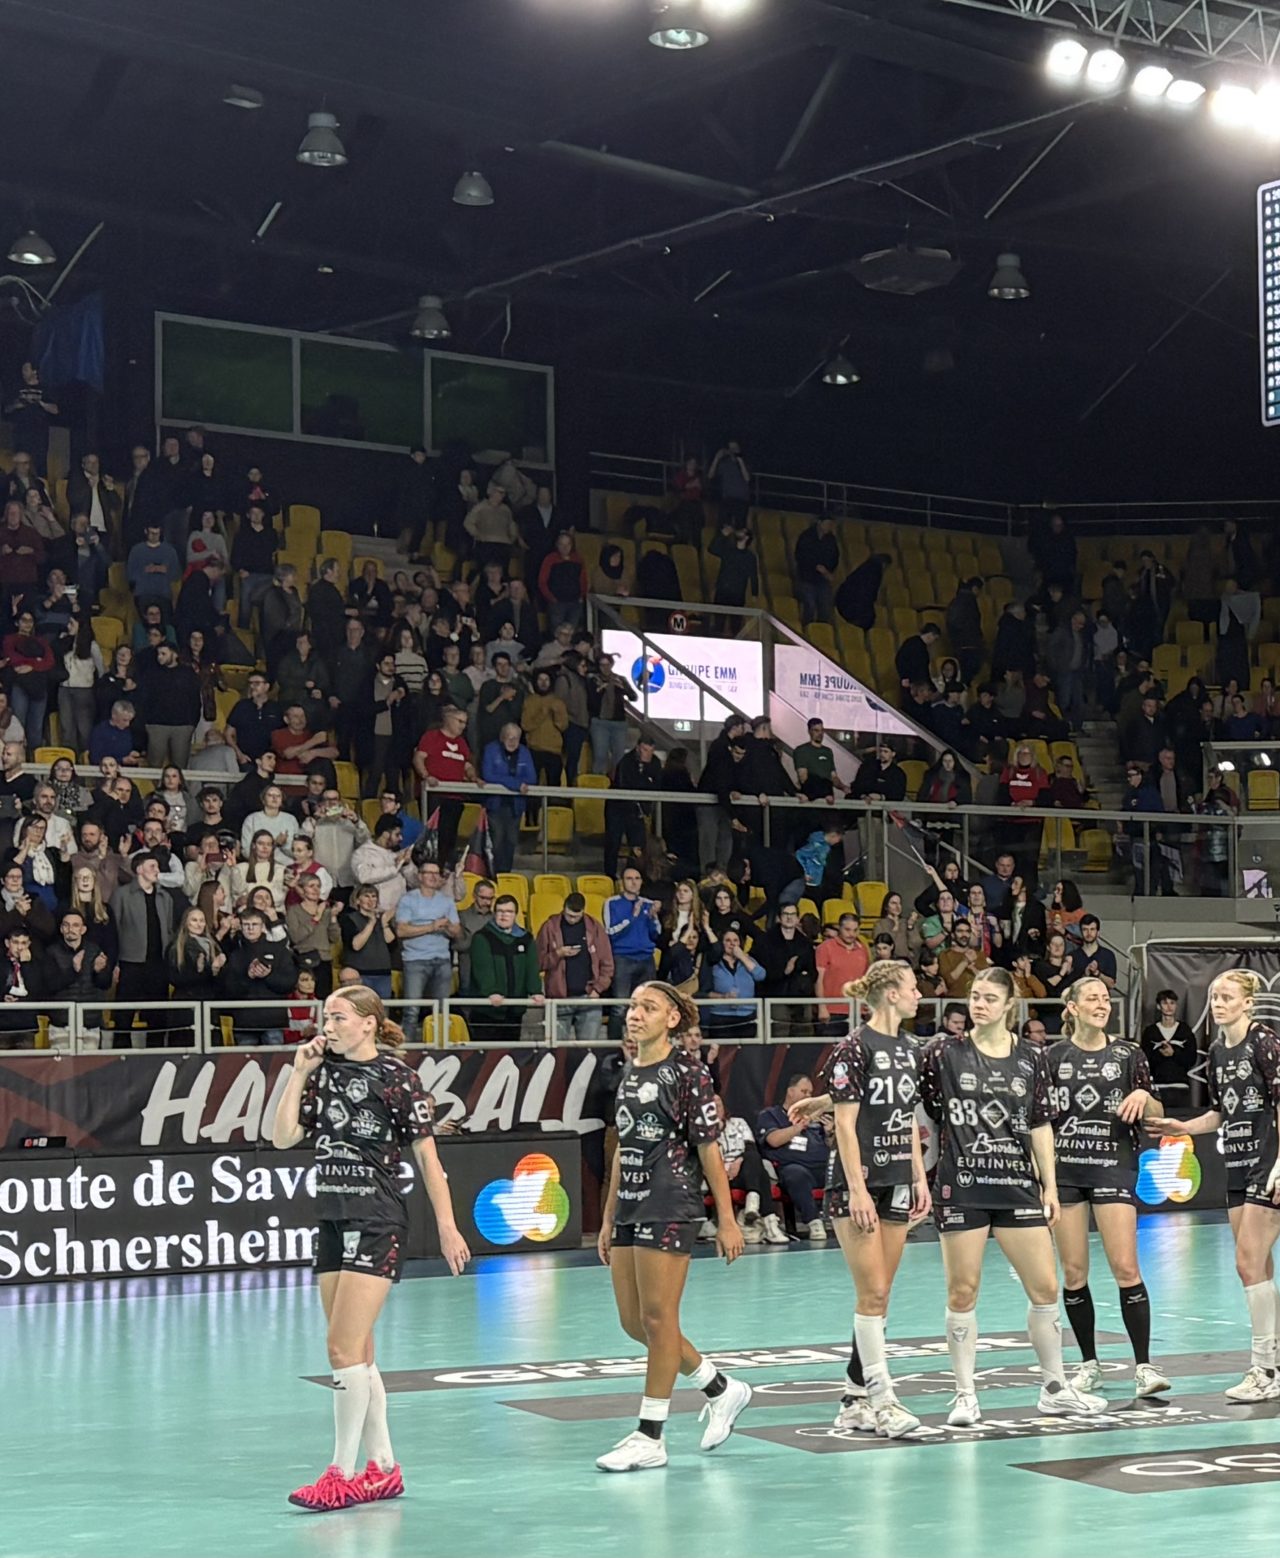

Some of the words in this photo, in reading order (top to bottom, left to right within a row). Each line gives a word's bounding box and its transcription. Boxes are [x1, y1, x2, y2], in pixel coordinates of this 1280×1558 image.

[673, 616, 684, 628] M
[668, 664, 710, 679] GUPE
[714, 666, 737, 680] EMM
[140, 1053, 605, 1146] HABALL
[869, 1076, 894, 1105] 21
[948, 1098, 979, 1127] 33
[1055, 1138, 1119, 1151] URINVEST
[316, 1163, 376, 1179] RINVEST
[957, 1156, 1032, 1172] EURINVEST
[133, 1160, 194, 1207] de
[433, 1349, 845, 1384] Grand
